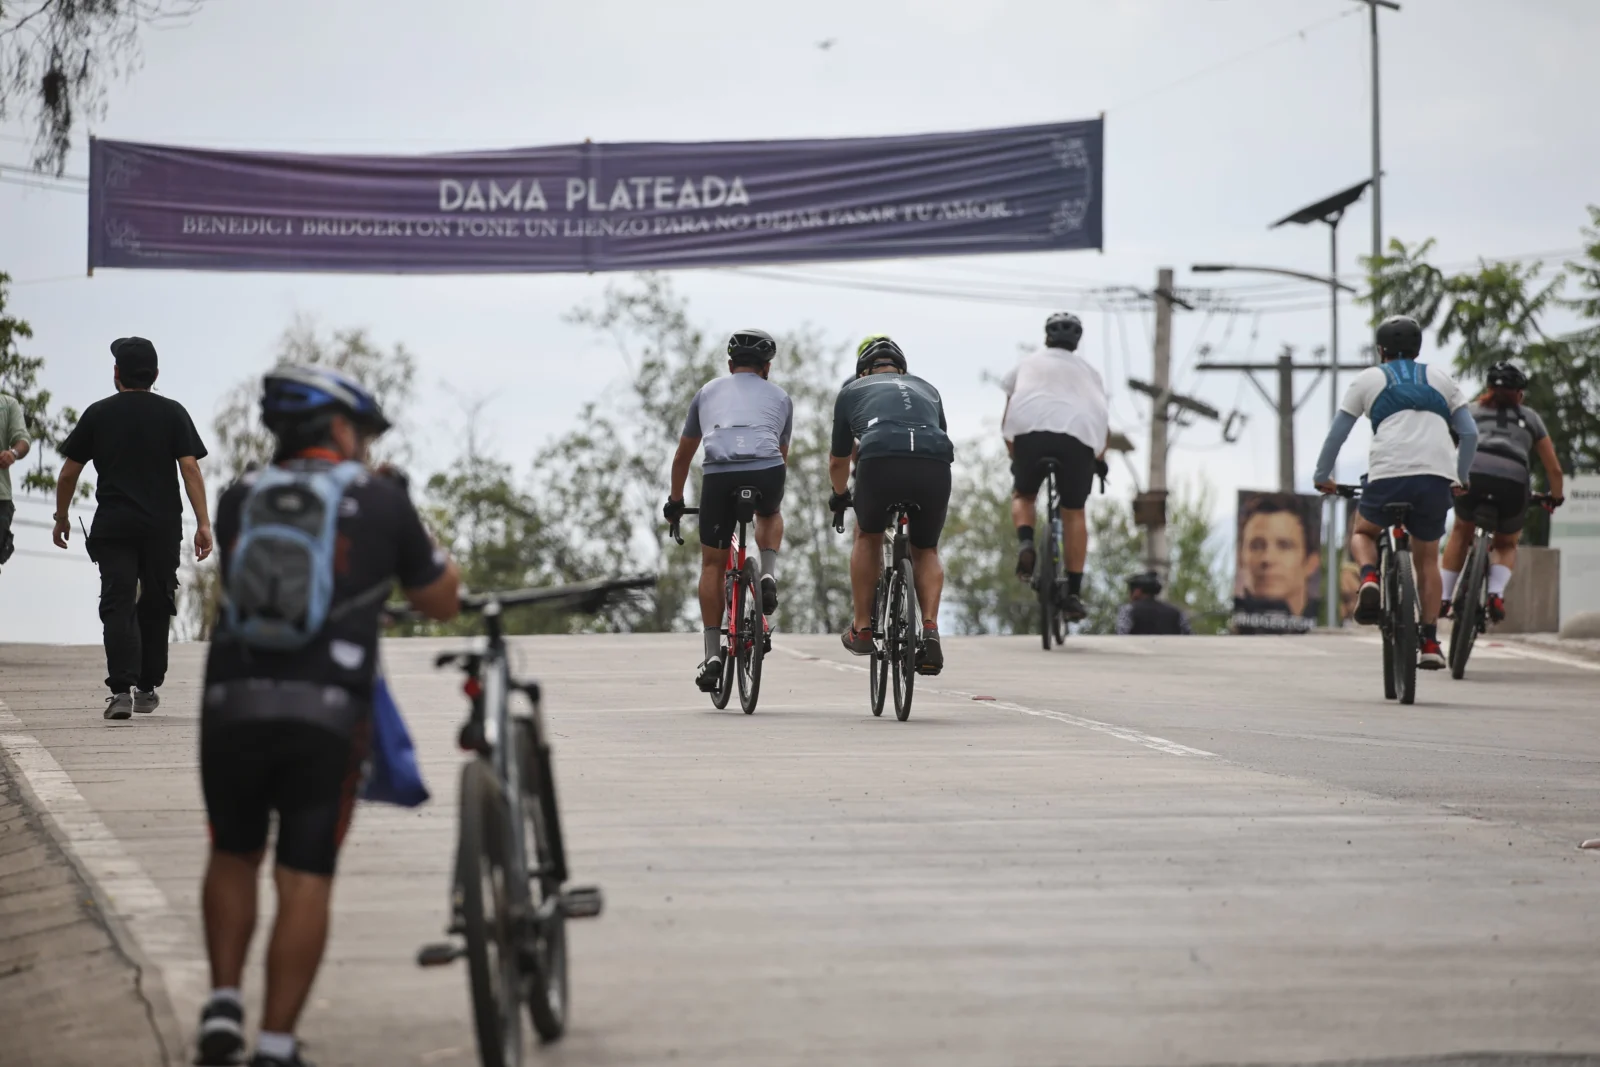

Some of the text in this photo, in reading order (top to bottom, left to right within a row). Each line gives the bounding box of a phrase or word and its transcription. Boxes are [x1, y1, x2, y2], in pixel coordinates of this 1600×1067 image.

[438, 175, 751, 212] DAMA PLATEADA
[302, 217, 451, 238] BRIDGERTON
[524, 217, 562, 237] UN
[564, 216, 649, 237] LIENZO
[714, 212, 751, 231] NO
